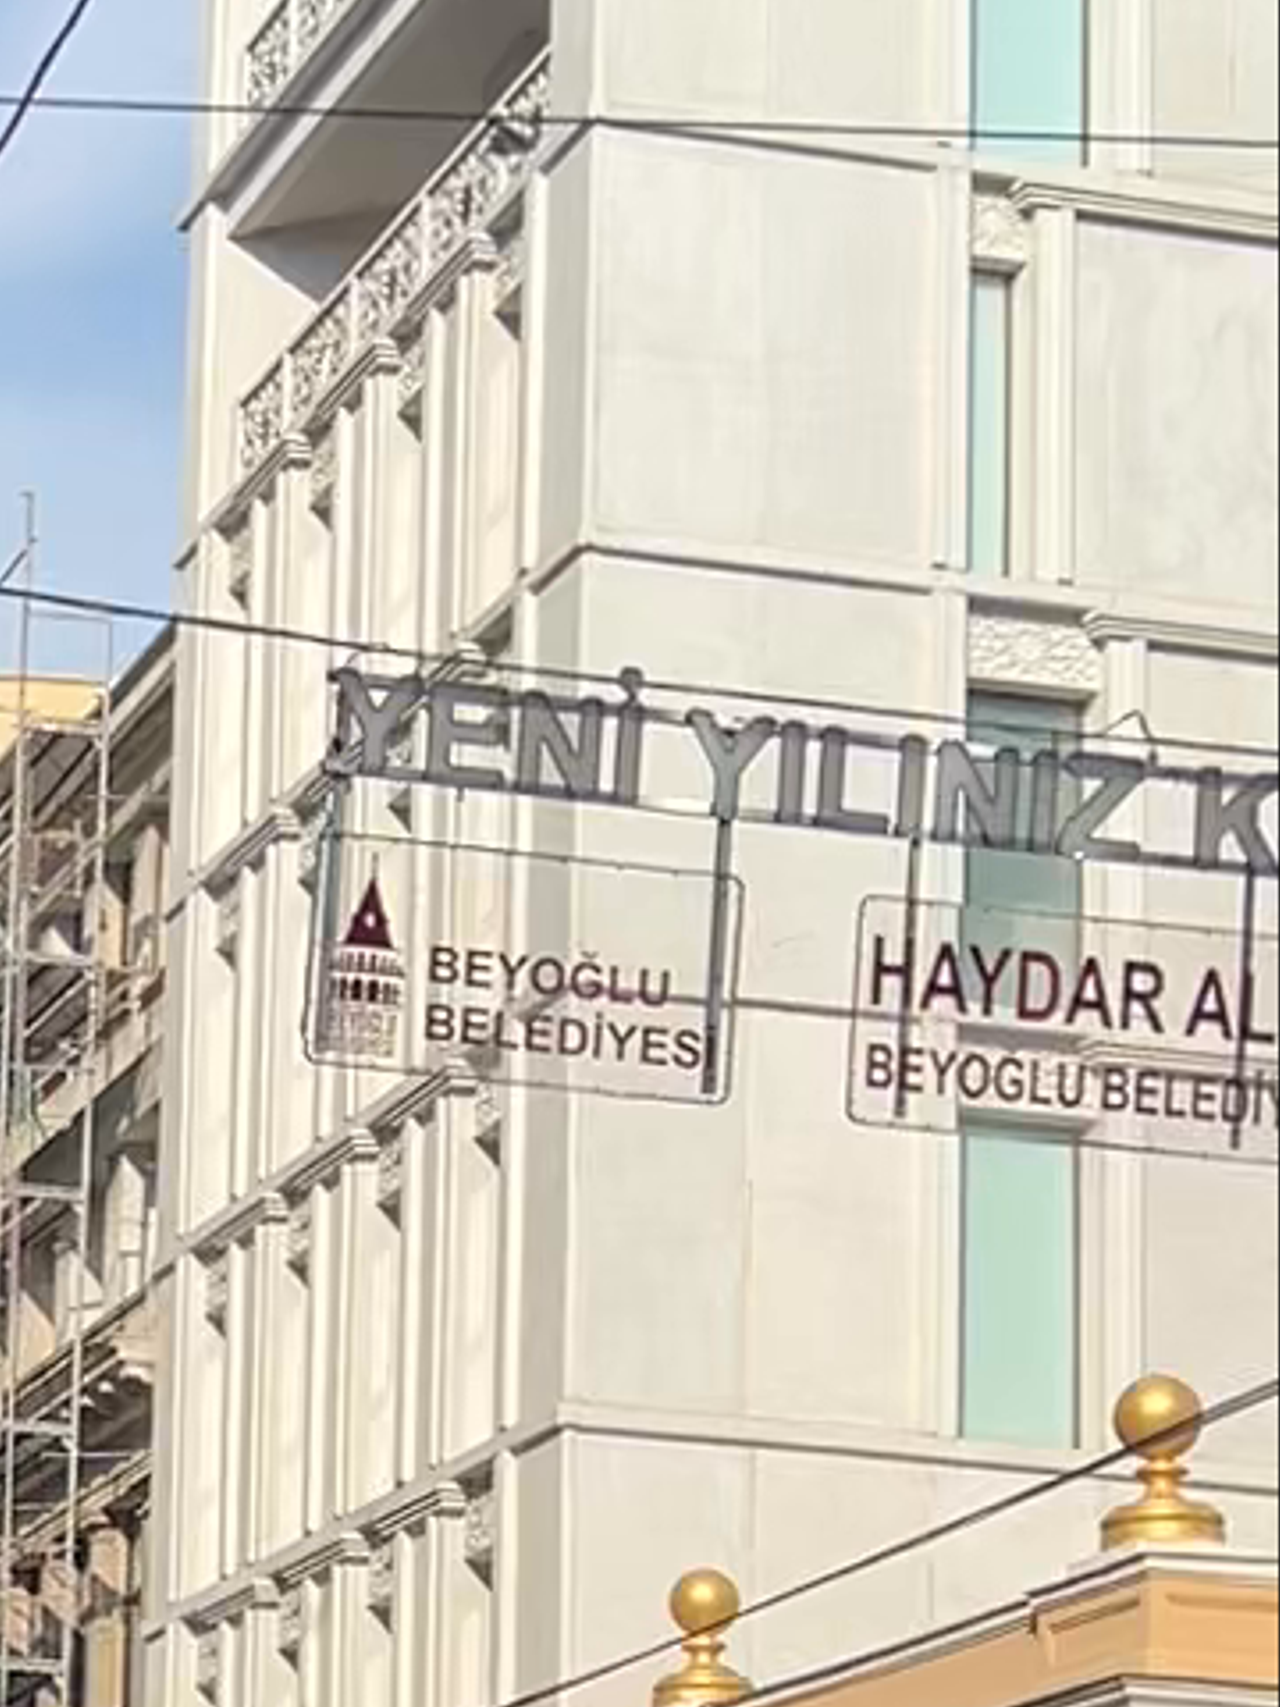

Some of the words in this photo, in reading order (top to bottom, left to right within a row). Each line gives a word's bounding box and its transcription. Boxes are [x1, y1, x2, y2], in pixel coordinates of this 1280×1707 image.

[329, 667, 642, 805] YENİ
[686, 708, 1145, 855] YILINIZ
[428, 947, 671, 1007] BEYOĞLU
[870, 935, 1164, 1034] HAYDAR
